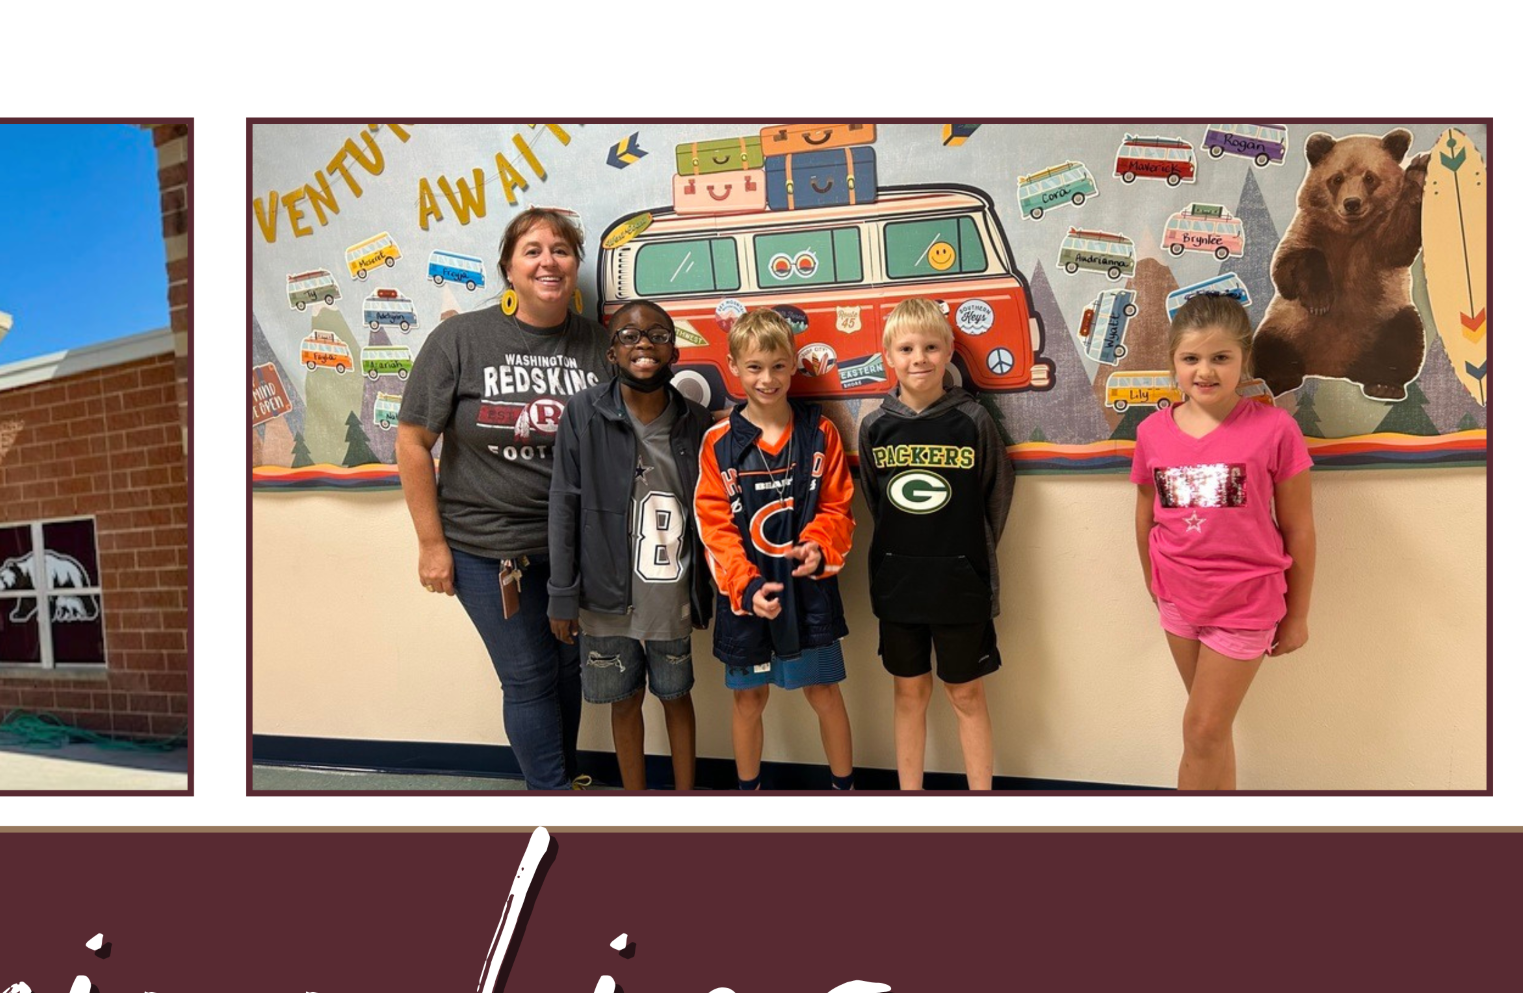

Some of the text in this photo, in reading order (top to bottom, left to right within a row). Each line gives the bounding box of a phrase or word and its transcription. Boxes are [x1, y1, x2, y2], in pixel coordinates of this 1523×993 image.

[1224, 133, 1266, 152] Rogan
[1128, 160, 1181, 173] Maverick
[1042, 187, 1072, 204] Cora
[841, 318, 855, 328] 45
[961, 311, 987, 324] Keys
[1104, 311, 1121, 348] Wyatt
[505, 353, 578, 369] WASHINGTON
[840, 362, 883, 379] EASTERN
[260, 396, 285, 414] OPEN
[872, 444, 975, 469] PACKERS
